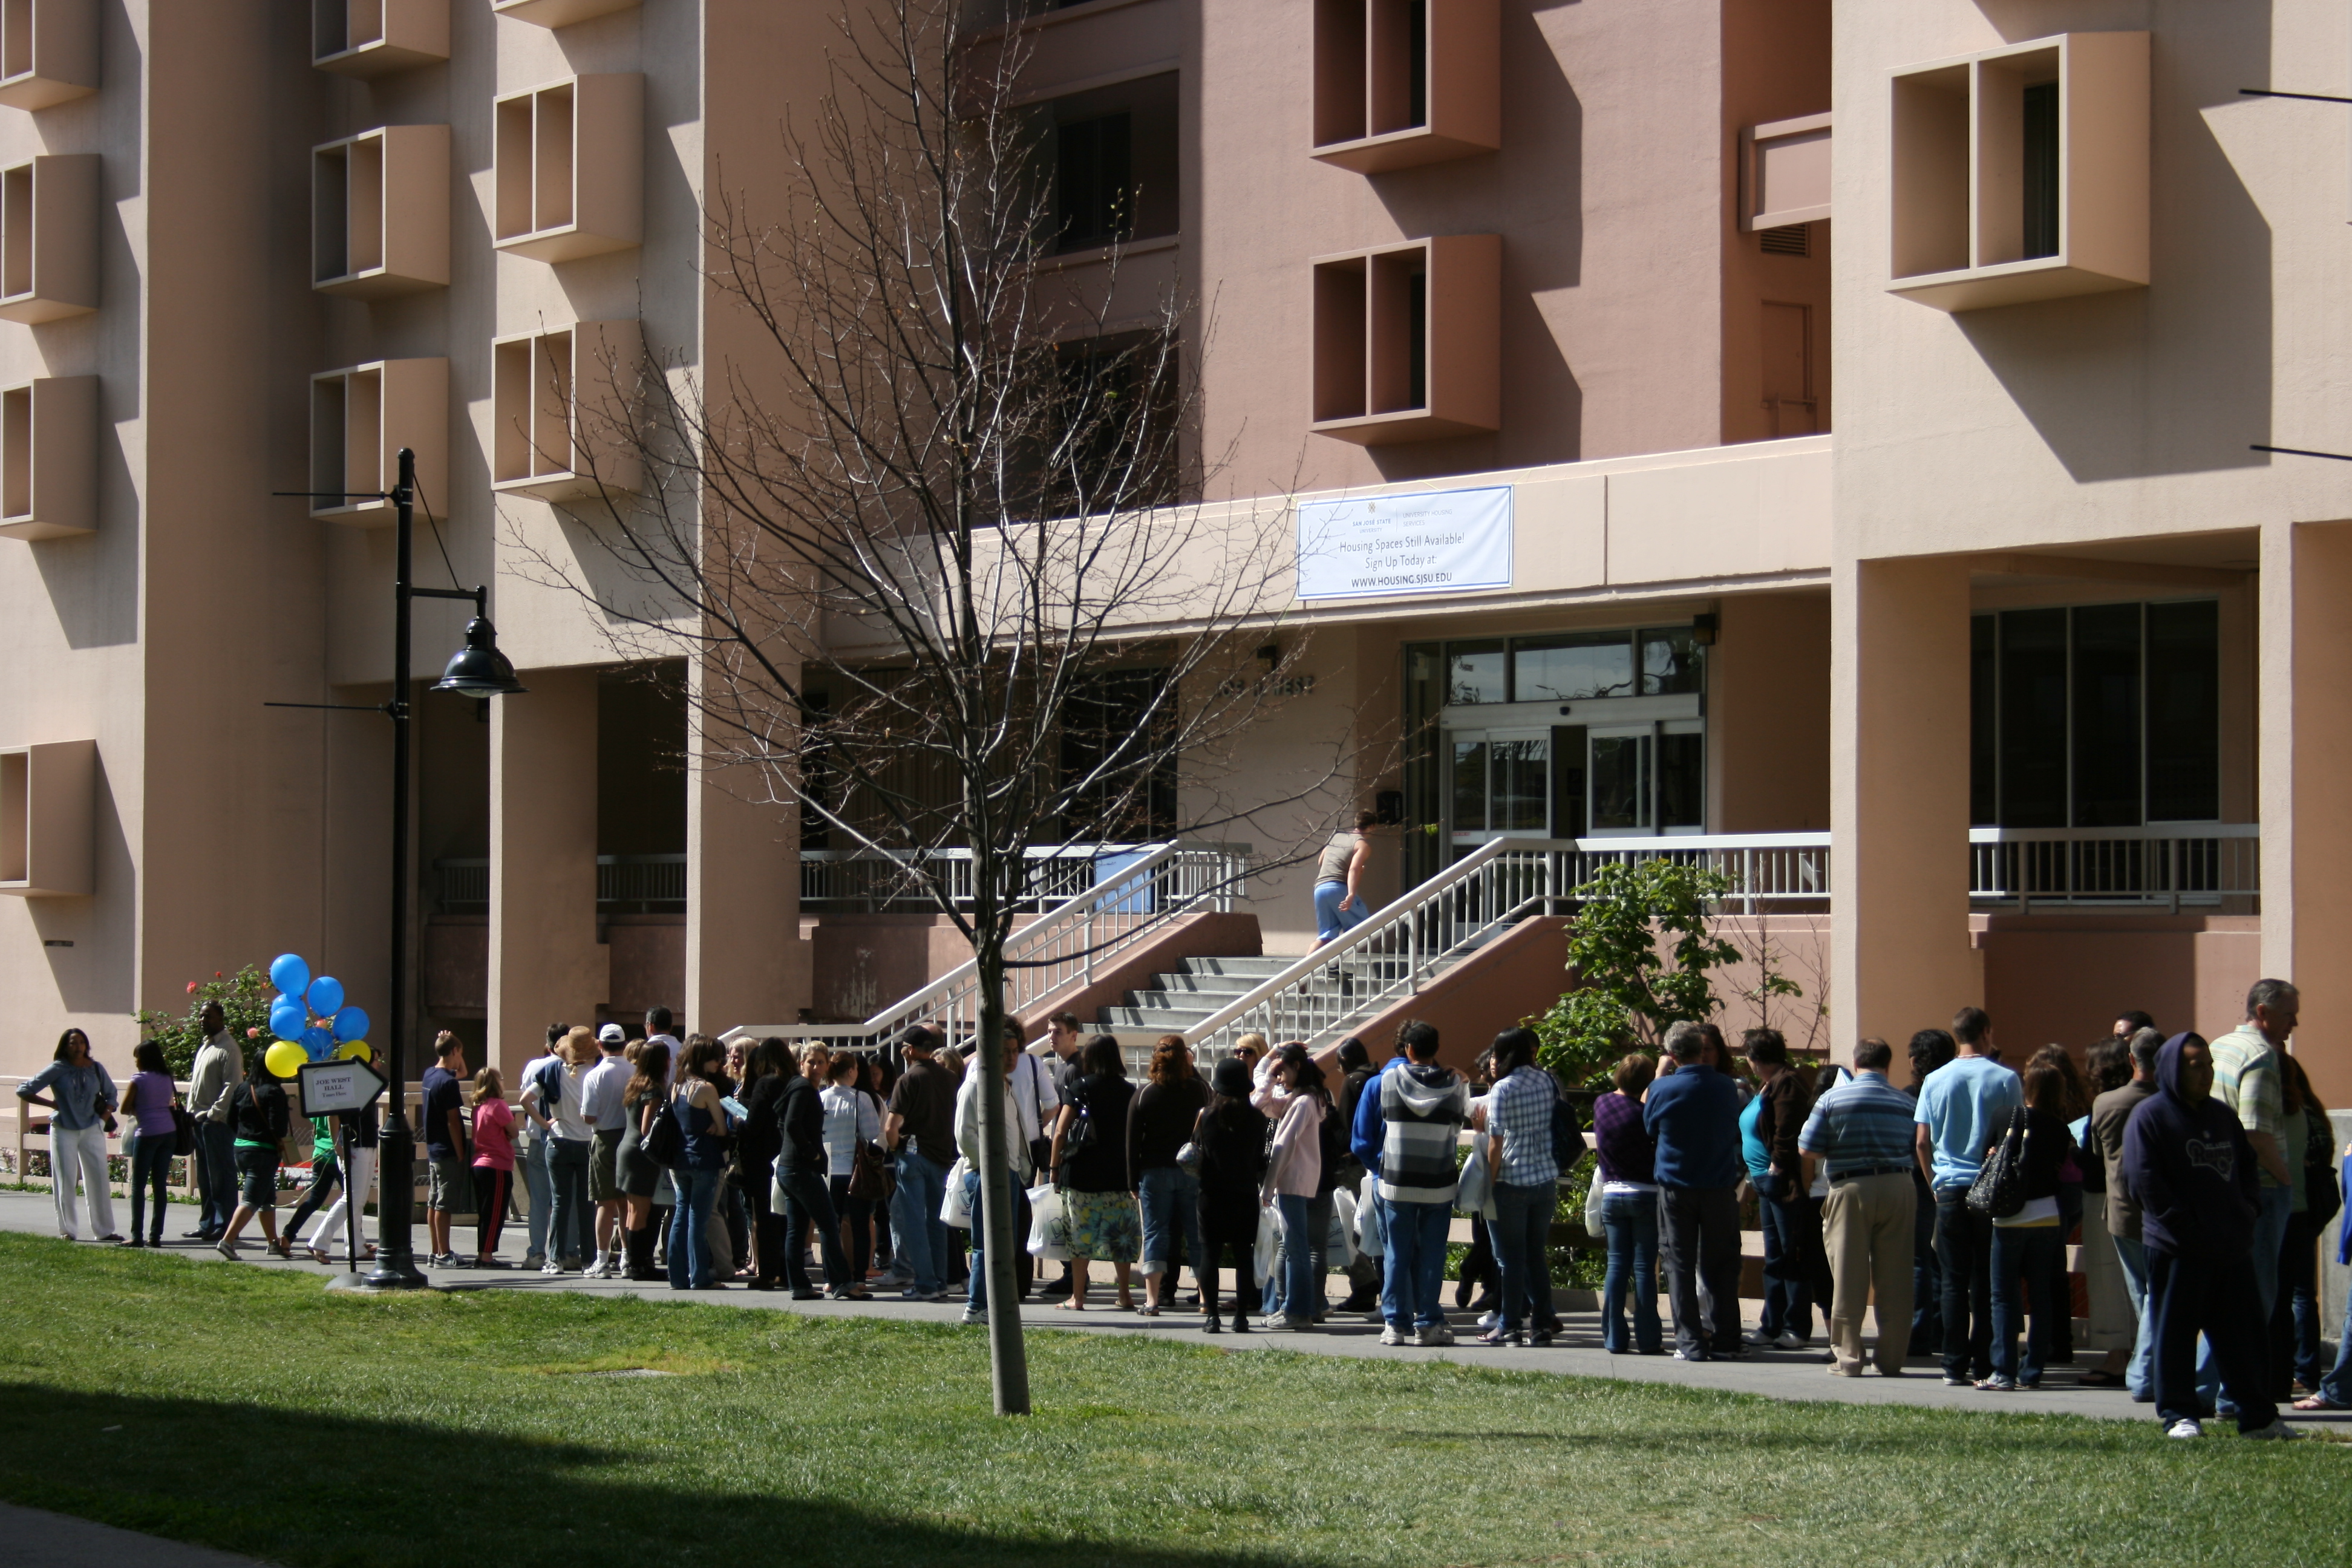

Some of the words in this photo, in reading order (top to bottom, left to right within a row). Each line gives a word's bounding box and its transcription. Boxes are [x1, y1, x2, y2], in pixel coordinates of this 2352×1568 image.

[1339, 538, 1373, 554] Housing
[1375, 538, 1403, 553] Spaces
[1405, 535, 1422, 548] Still
[1424, 532, 1465, 546] Available!
[1365, 557, 1382, 572] Sign
[1385, 556, 1397, 570] Up
[1399, 554, 1425, 569] Today
[1427, 555, 1437, 564] at:
[1351, 572, 1452, 588] WWW.HOUSING.SJSU.EDU
